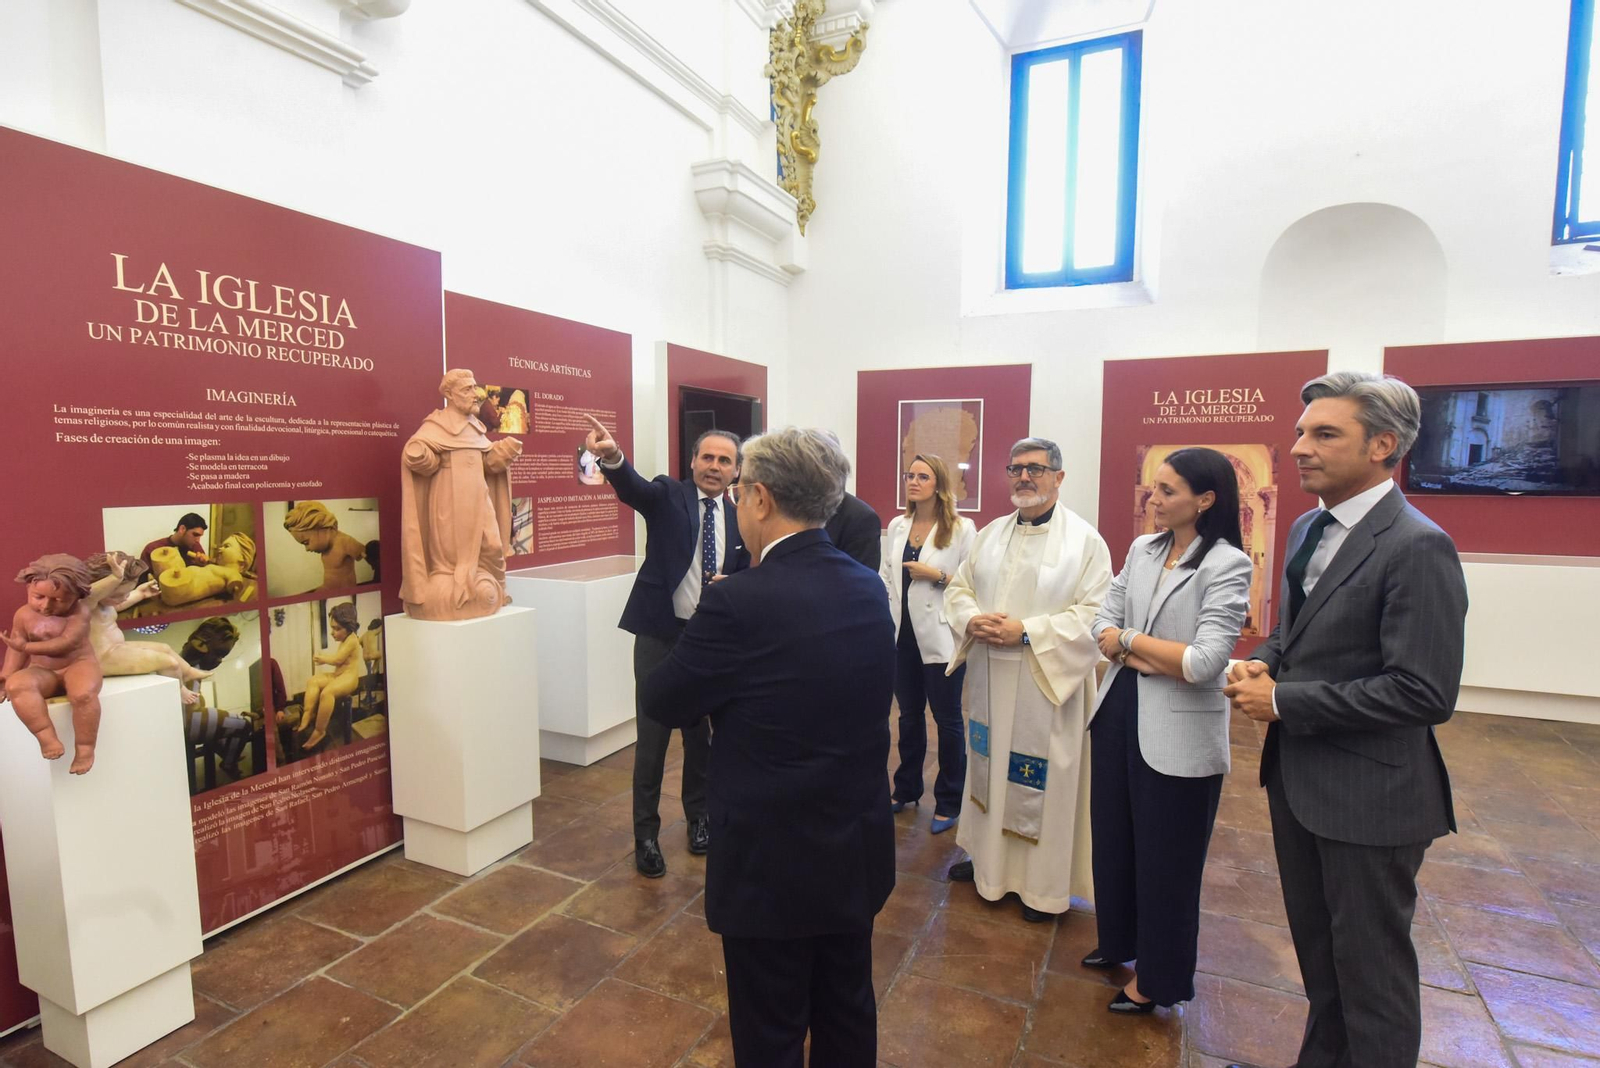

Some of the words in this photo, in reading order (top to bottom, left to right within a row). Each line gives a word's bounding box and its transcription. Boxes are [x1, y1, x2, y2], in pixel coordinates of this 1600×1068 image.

[110, 252, 184, 300] LA
[195, 269, 358, 329] IGLESIA
[133, 298, 181, 327] DE
[188, 307, 229, 335] LA
[236, 314, 345, 351] MERCED
[86, 322, 123, 343] UN
[129, 327, 261, 359] PATRIMONIO
[266, 345, 374, 372] RECUPERADO
[508, 356, 549, 372] TÉCNICAS
[550, 364, 592, 378] ARTÍSTICAS
[206, 388, 297, 407] IMAGINERÍA
[542, 392, 564, 401] DORADO
[1153, 391, 1179, 406] LA
[1185, 388, 1266, 405] IGLESIA
[53, 404, 67, 413] La
[70, 405, 120, 416] imaginería
[135, 409, 151, 417] una
[153, 411, 203, 420] especialidad
[204, 412, 217, 420] del
[235, 414, 244, 422] de
[288, 416, 316, 425] dedicada
[1160, 406, 1177, 416] DE
[1180, 405, 1197, 416] LA
[1201, 404, 1257, 415] MERCED
[54, 416, 83, 425] temas
[84, 417, 131, 428] religiosos,
[132, 420, 147, 429] por
[148, 419, 156, 428] lo
[157, 421, 185, 429] común
[186, 422, 214, 430] realista
[214, 424, 219, 432] y
[235, 424, 266, 432] finalidad
[1143, 417, 1156, 425] UN
[1157, 416, 1212, 424] PATRIMONIO
[1213, 414, 1275, 424] RECUPERADO
[56, 432, 88, 443] Fases
[90, 433, 104, 443] de
[105, 434, 150, 444] creación
[151, 435, 163, 444] de
[184, 436, 221, 447] imagen:
[185, 453, 199, 461] -Se
[199, 453, 226, 462] plasma
[227, 453, 233, 461] la
[235, 453, 250, 461] idea
[269, 453, 290, 463] dibujo
[186, 463, 199, 471] -Se
[200, 463, 228, 471] modela
[186, 472, 199, 480] -Se
[200, 474, 218, 482] pasa
[223, 472, 250, 480] madera
[187, 482, 224, 490] -Acabado
[225, 481, 241, 489] final
[194, 805, 201, 813] la
[203, 795, 229, 810] Iglesia
[230, 792, 240, 800] de
[250, 778, 277, 793] Merced
[278, 774, 291, 783] han
